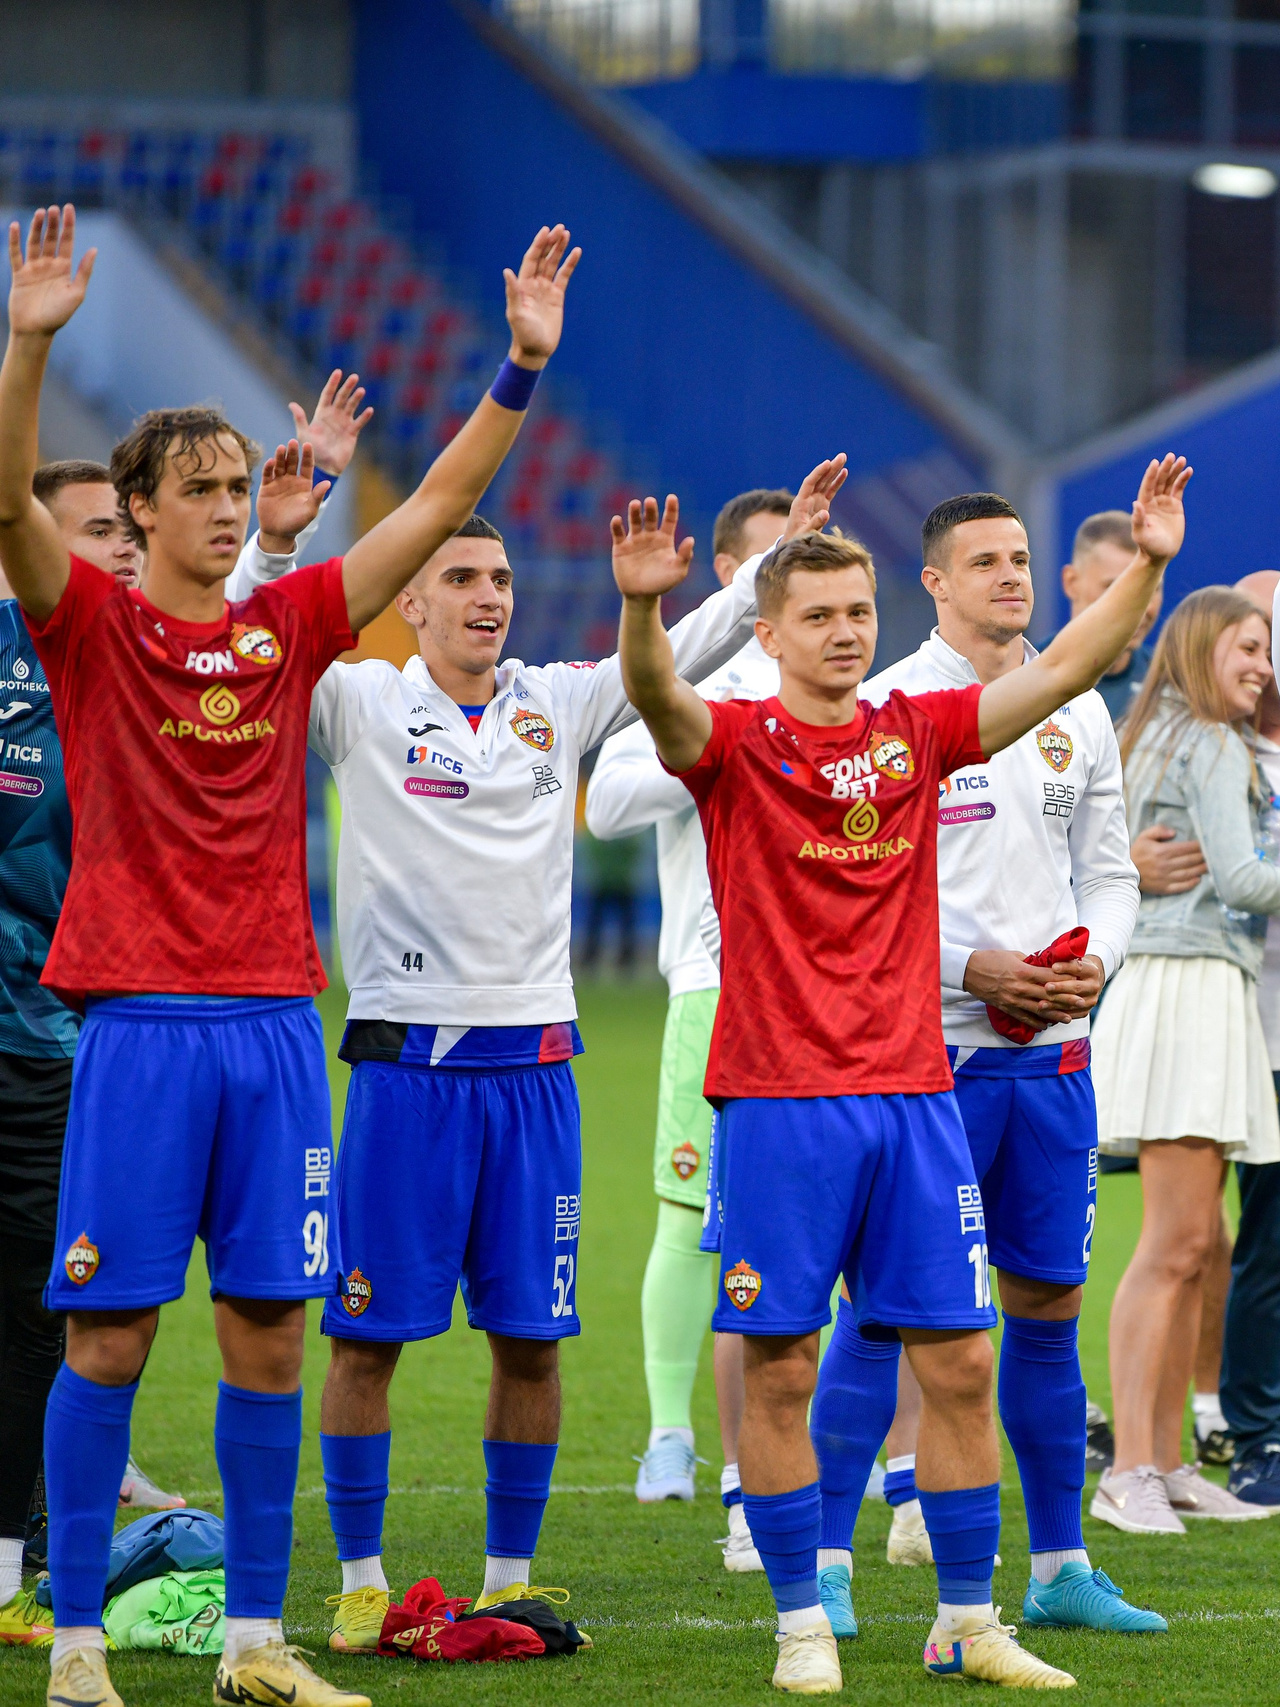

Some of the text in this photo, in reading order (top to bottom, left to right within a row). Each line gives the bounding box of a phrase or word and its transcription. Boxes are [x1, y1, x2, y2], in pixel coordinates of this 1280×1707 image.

[516, 718, 549, 735] ЦСКА
[1040, 735, 1070, 751] ЦСКА
[6, 743, 42, 763] ПСБ
[873, 740, 908, 767] ЦСКА
[431, 751, 464, 775] ПСБ
[409, 781, 464, 795] WILDBERRIES
[831, 773, 880, 799] BET
[956, 775, 989, 791] ПСБ
[1043, 782, 1075, 800] ВЭБ
[941, 806, 992, 820] WILDBERRIES
[401, 952, 423, 972] 44
[727, 1275, 758, 1290] ЦСКА
[968, 1243, 991, 1308] 10
[347, 1281, 369, 1297] СКА
[551, 1254, 574, 1318] 52
